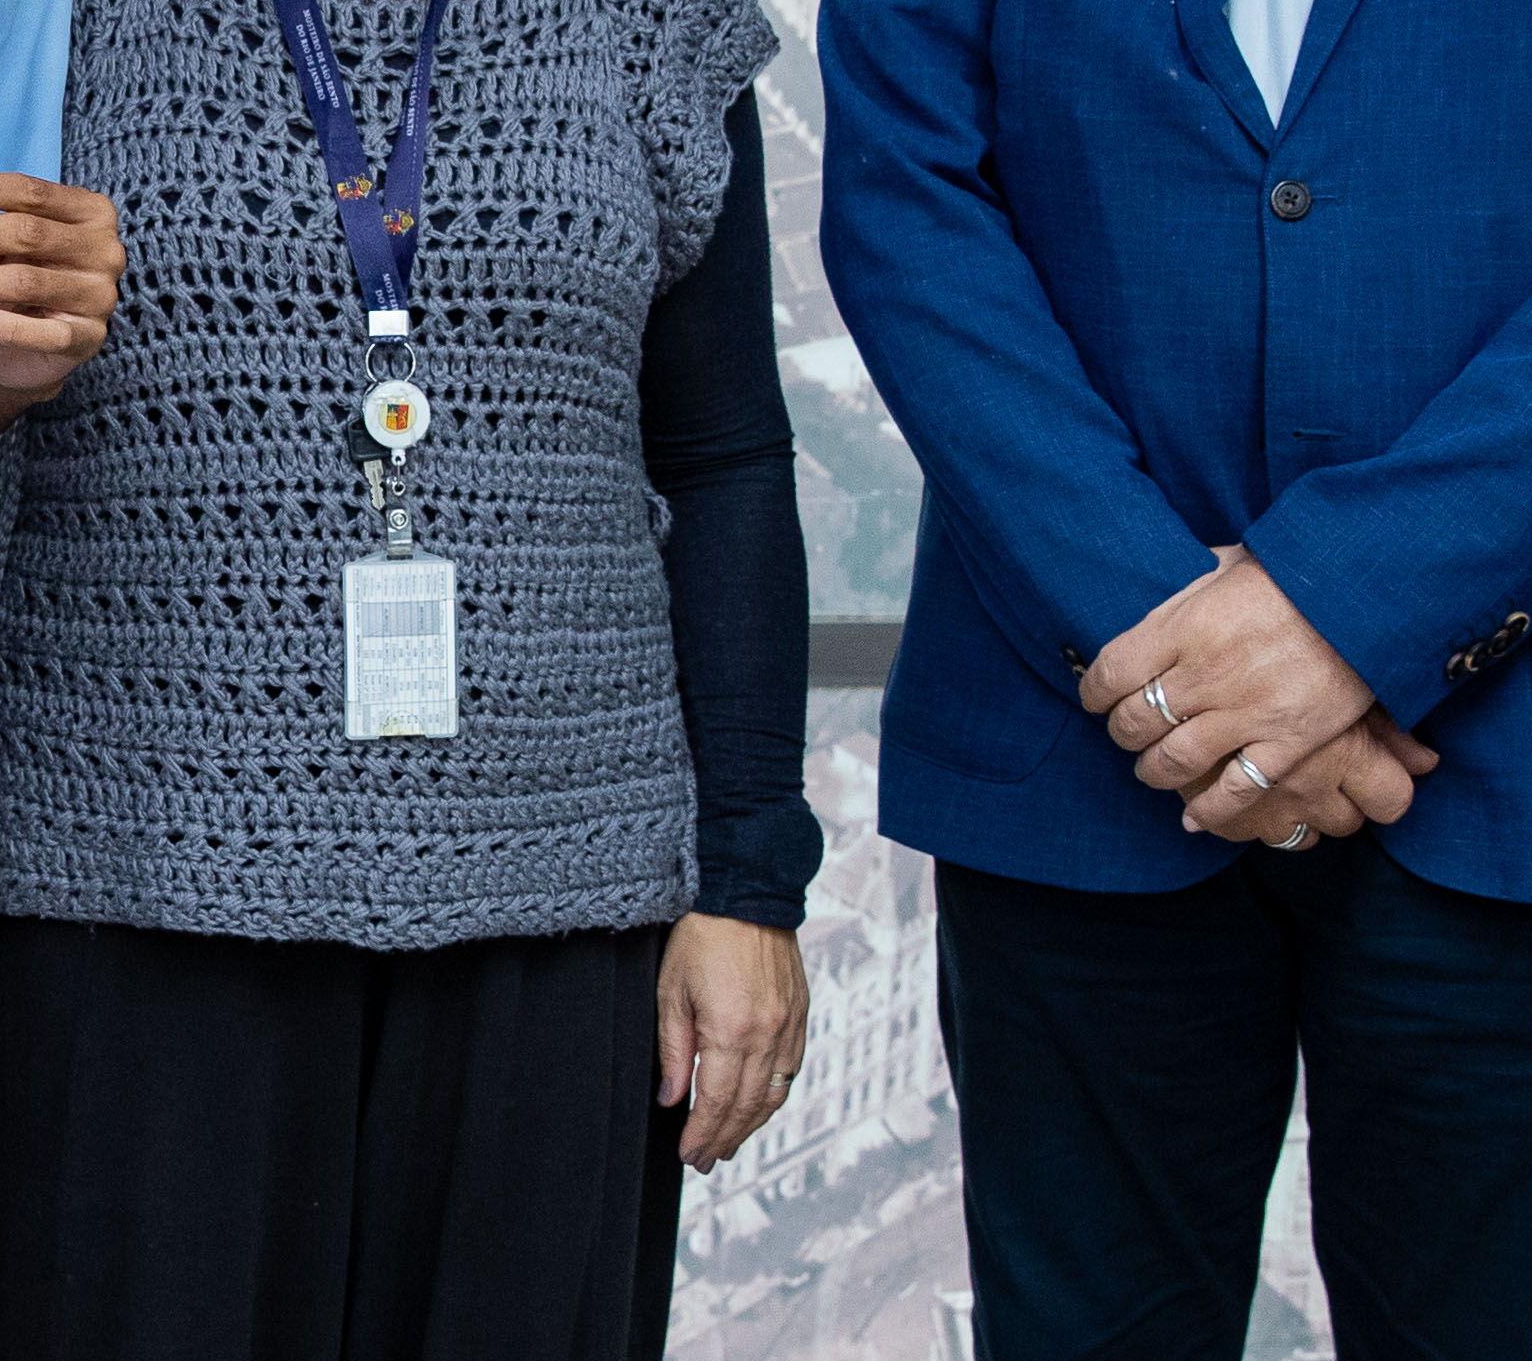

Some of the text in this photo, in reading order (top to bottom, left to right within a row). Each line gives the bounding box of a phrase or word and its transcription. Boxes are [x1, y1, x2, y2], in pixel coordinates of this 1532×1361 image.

[296, 24, 325, 100] DO RIO DE JANEIRO
[303, 9, 340, 108] MOSTEIRO DE SÃO BENTO
[406, 107, 415, 136] BENTO
[376, 290, 385, 304] DO
